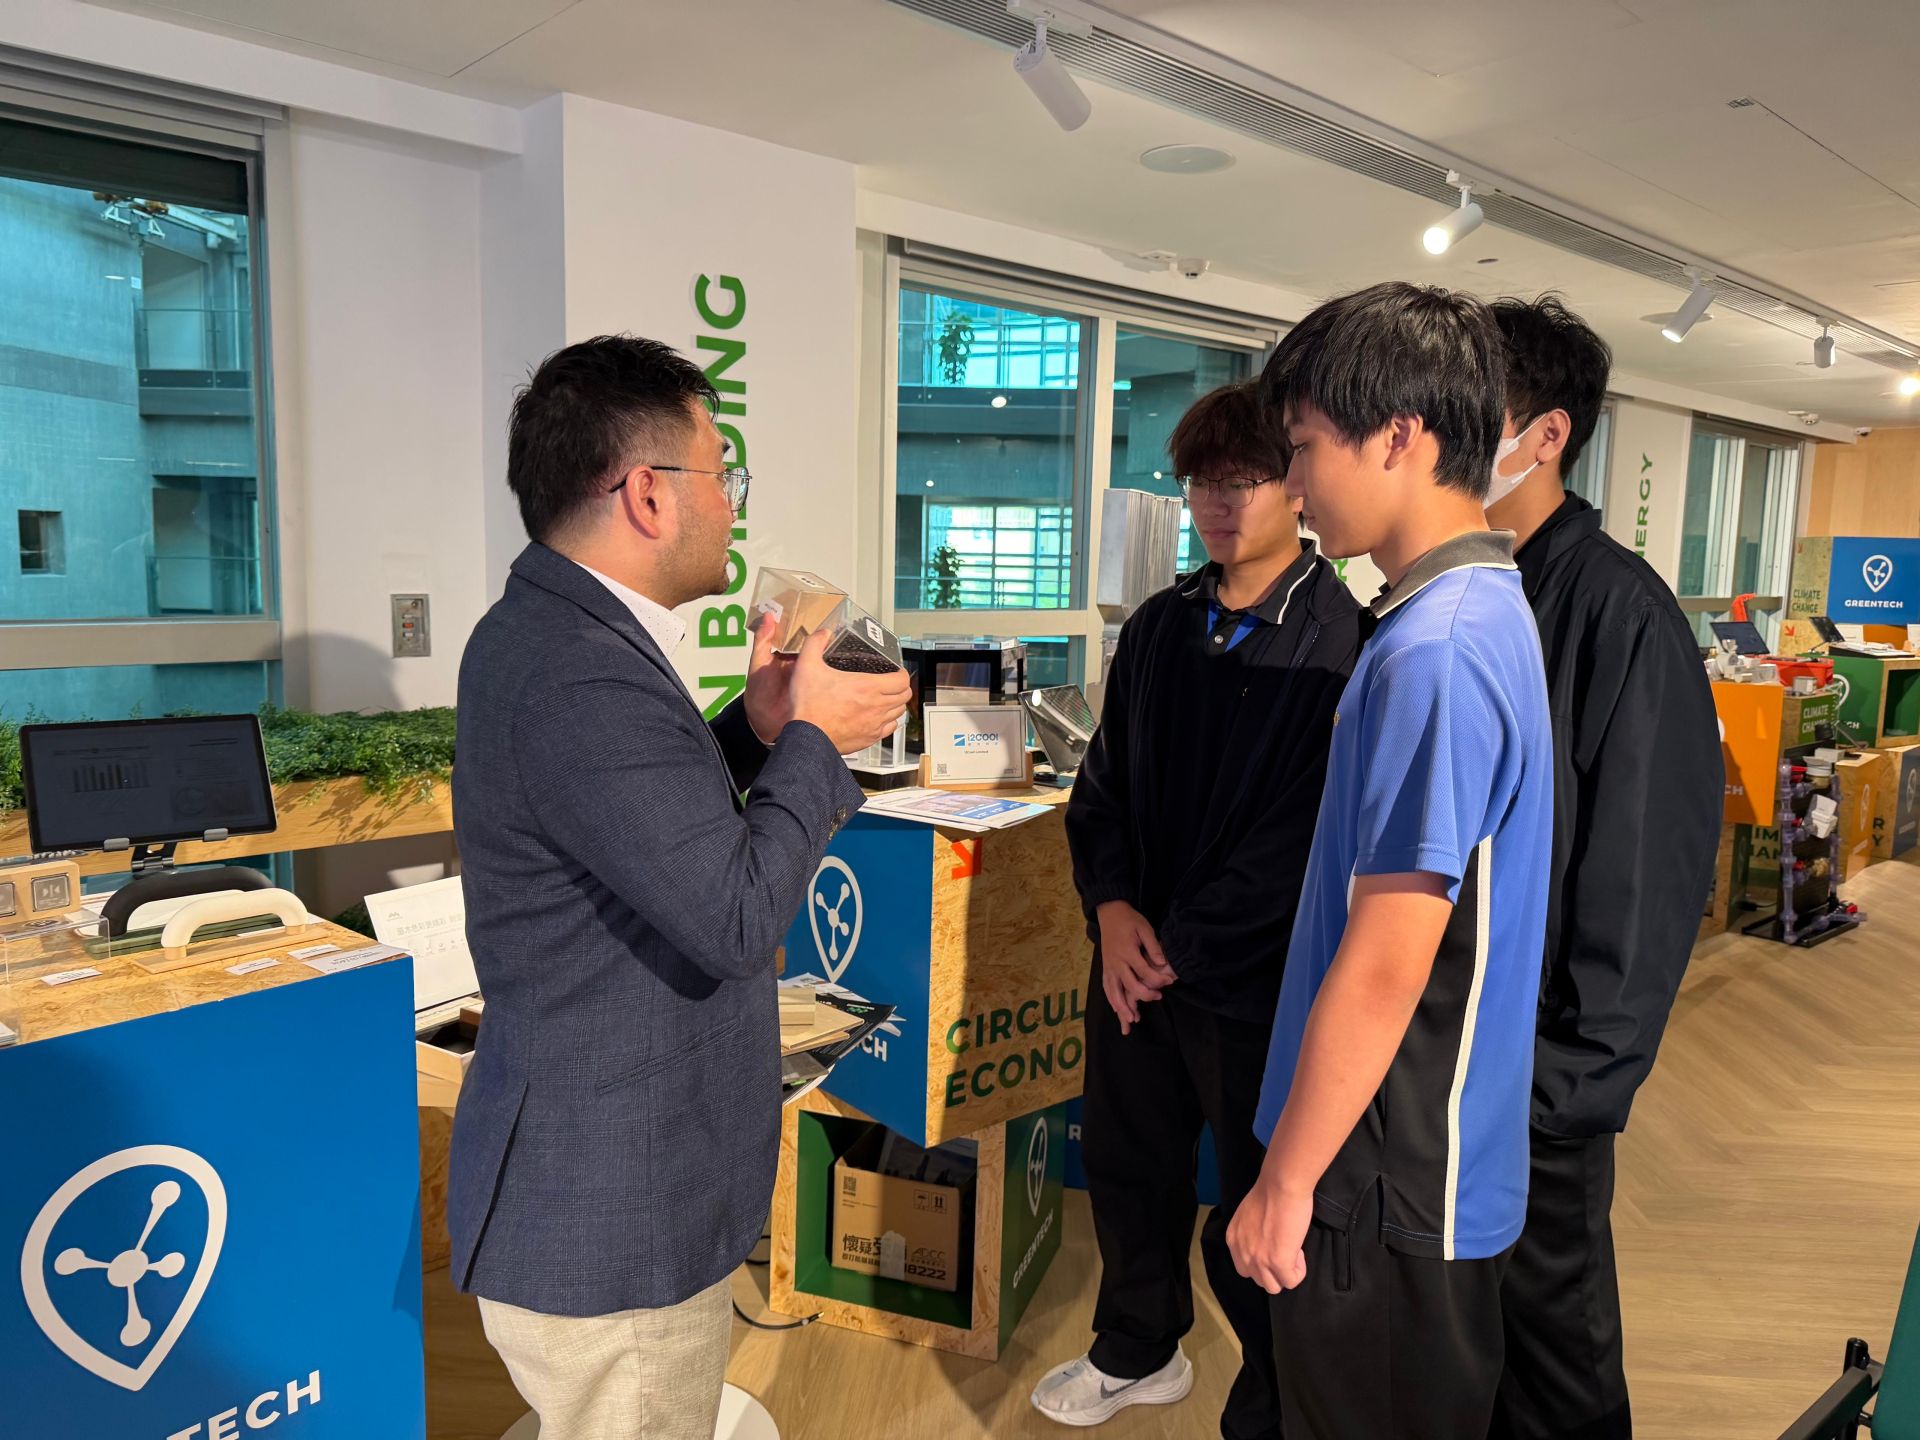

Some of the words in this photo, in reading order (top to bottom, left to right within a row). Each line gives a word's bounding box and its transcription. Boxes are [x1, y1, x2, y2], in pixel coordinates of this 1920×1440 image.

[1793, 589, 1821, 600] CLIMATE
[1792, 602, 1819, 614] CHANGE
[1844, 600, 1904, 609] GREENTECH
[1803, 704, 1829, 719] CLIMATE
[945, 1037, 1083, 1108] ECONO
[1013, 1208, 1053, 1288] GREENTECH
